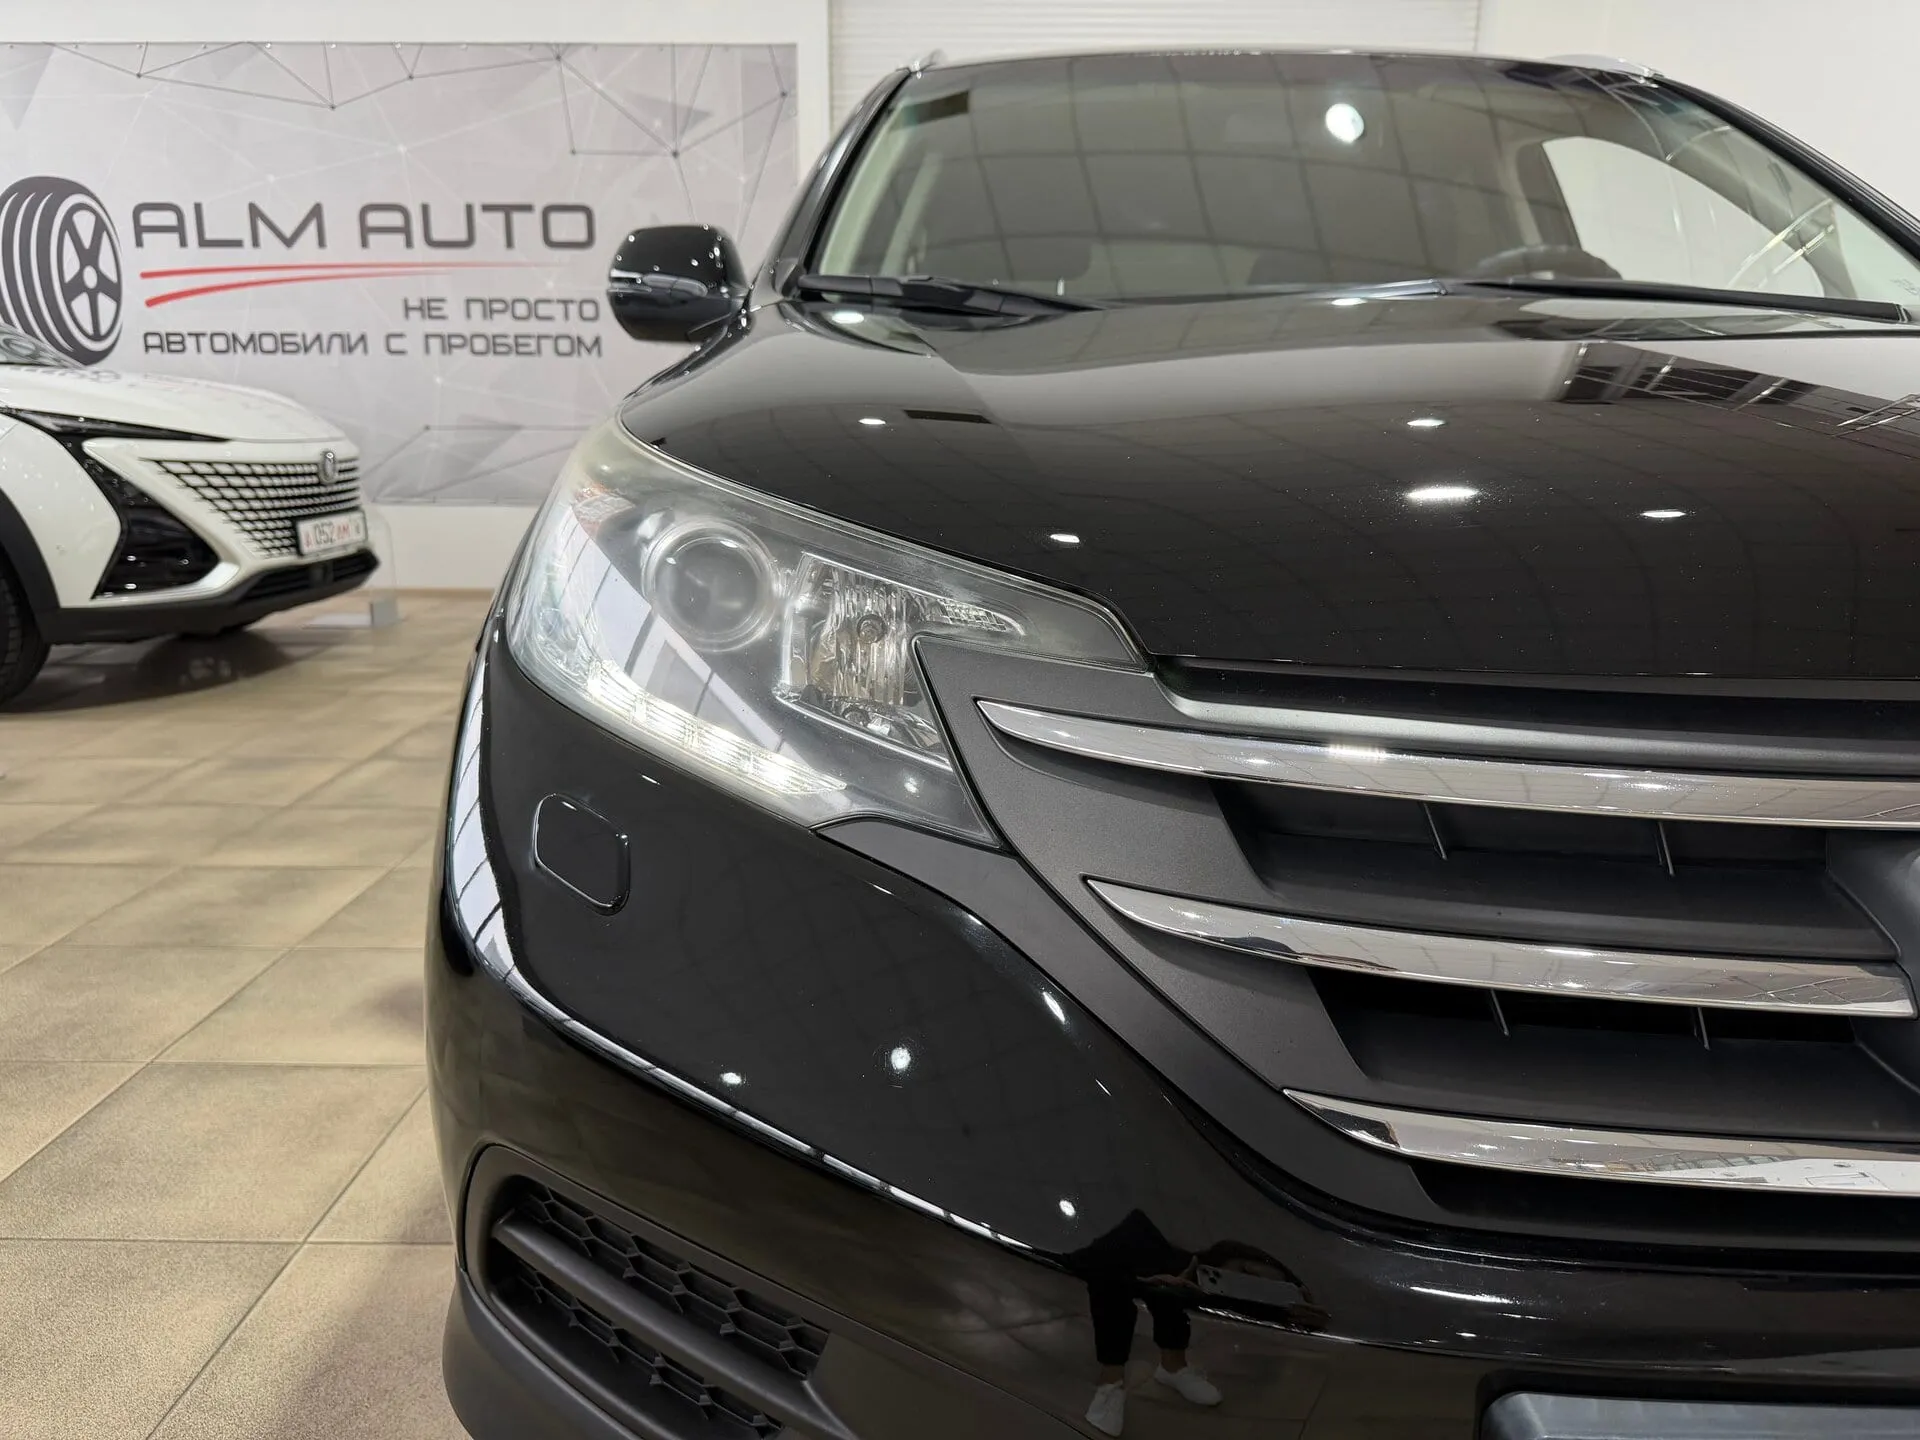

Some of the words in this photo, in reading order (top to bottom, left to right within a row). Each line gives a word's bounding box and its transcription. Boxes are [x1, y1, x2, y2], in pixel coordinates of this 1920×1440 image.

[132, 202, 327, 248] ALM
[359, 203, 596, 249] AUTO
[403, 297, 448, 320] НЕ
[465, 298, 599, 321] ПРОСТО
[143, 331, 369, 355] АВТОМОБИЛИ
[385, 333, 408, 355] С
[424, 333, 602, 357] ПРОБЕГОМ
